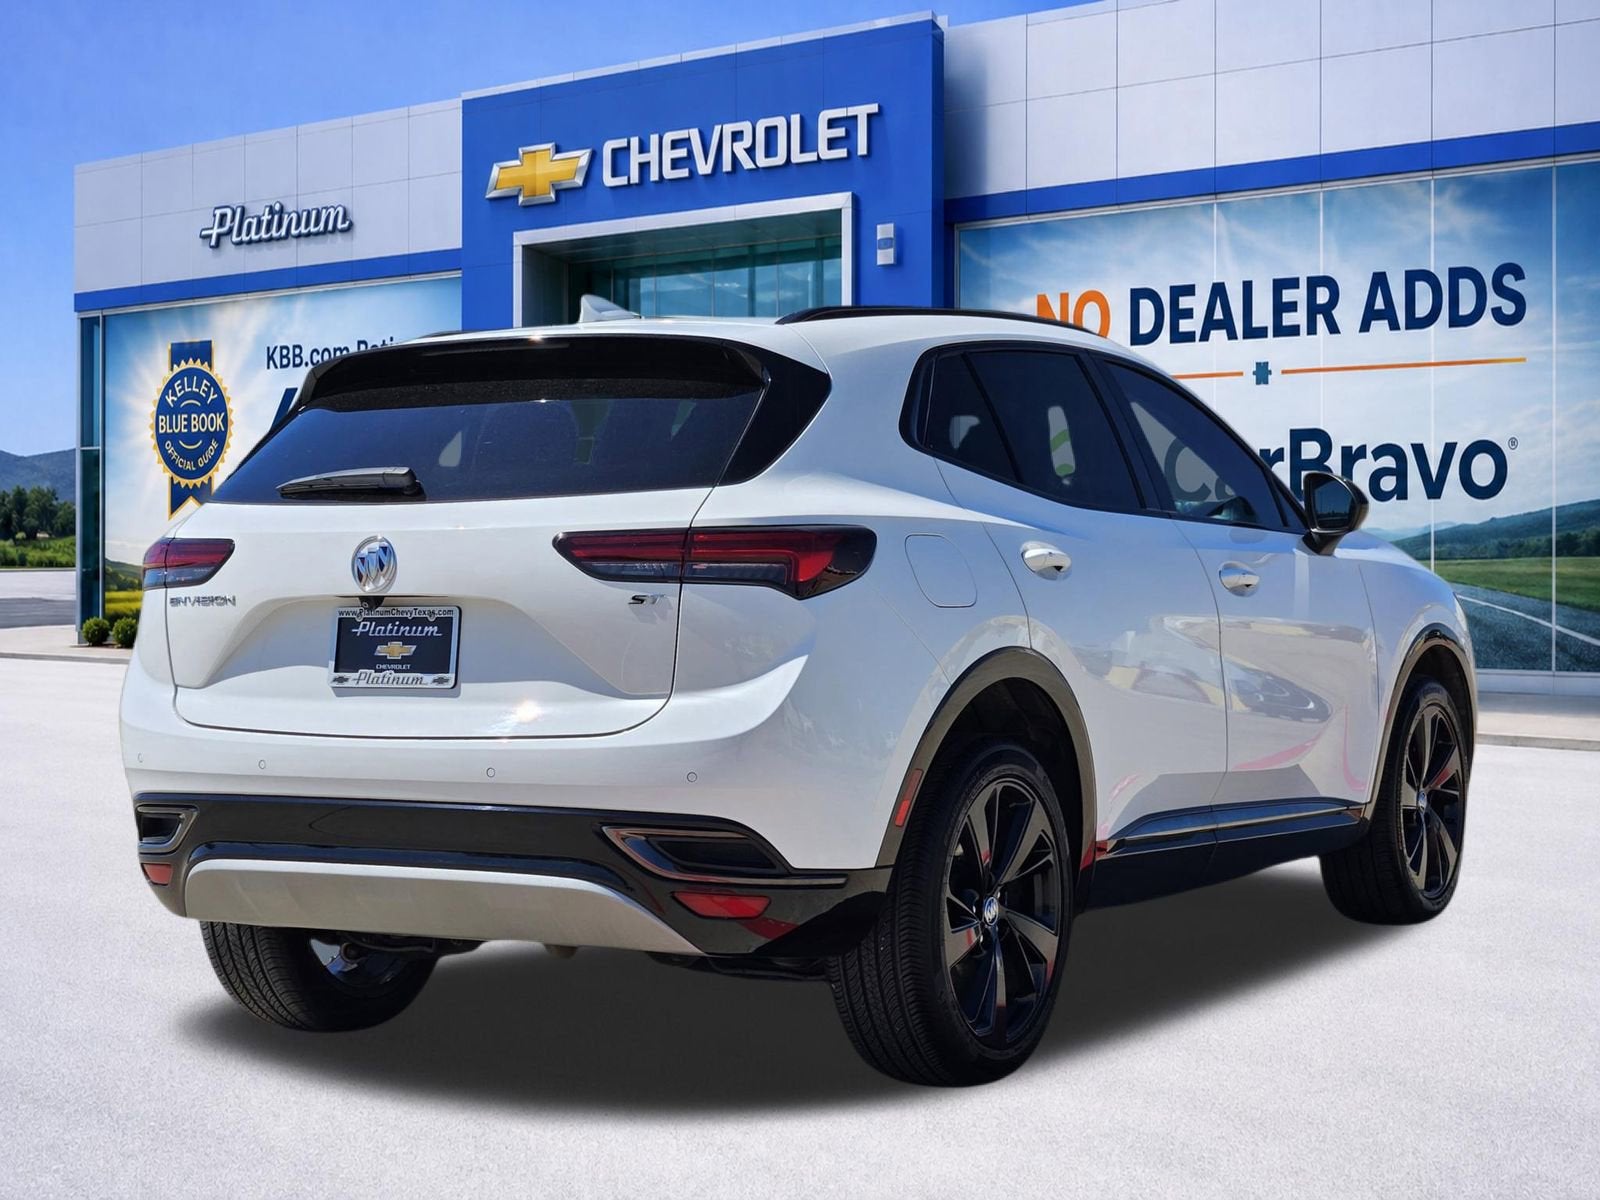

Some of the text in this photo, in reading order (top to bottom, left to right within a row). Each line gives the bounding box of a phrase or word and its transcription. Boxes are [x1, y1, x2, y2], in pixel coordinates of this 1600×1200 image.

[601, 103, 879, 188] CHEVROLET
[200, 201, 352, 249] Platinum
[1037, 262, 1527, 347] NO DEALER ADDS
[165, 375, 218, 408] KELLEY
[158, 411, 226, 434] BLUE BOOK
[164, 438, 220, 471] OFFICIAL GUIDE
[169, 595, 237, 608] ENVISION
[337, 607, 454, 619] www.PlatinumChevyTexas.com
[352, 621, 443, 637] Platinum
[352, 671, 429, 686] Platinum
